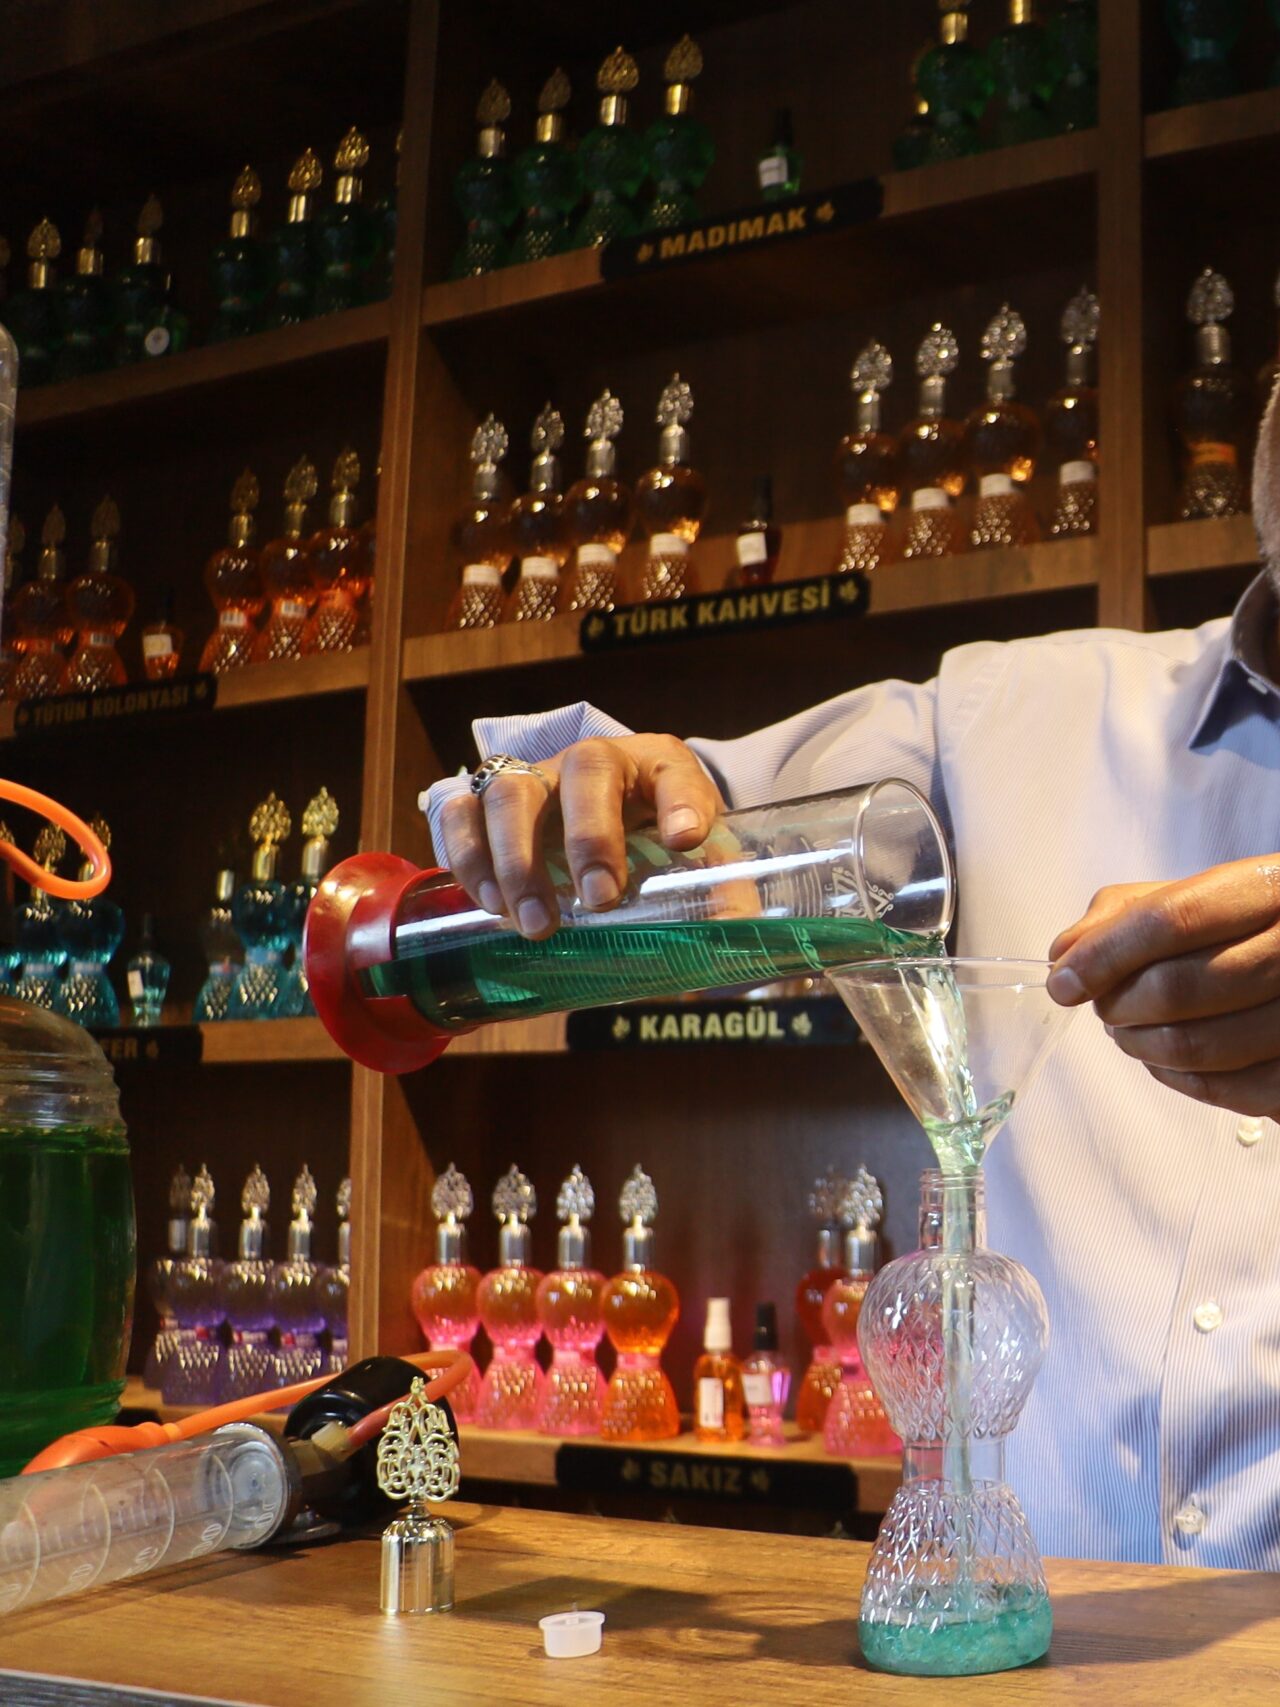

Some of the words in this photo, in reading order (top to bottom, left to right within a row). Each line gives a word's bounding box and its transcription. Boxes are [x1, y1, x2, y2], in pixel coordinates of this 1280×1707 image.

[659, 206, 807, 259] MADIMAK
[614, 604, 689, 637] TÜRK
[697, 580, 830, 626] KAHVESİ
[91, 685, 190, 720] KOLONYASI
[638, 1006, 786, 1041] KARAGÜL
[649, 1459, 744, 1494] SAKIZ
